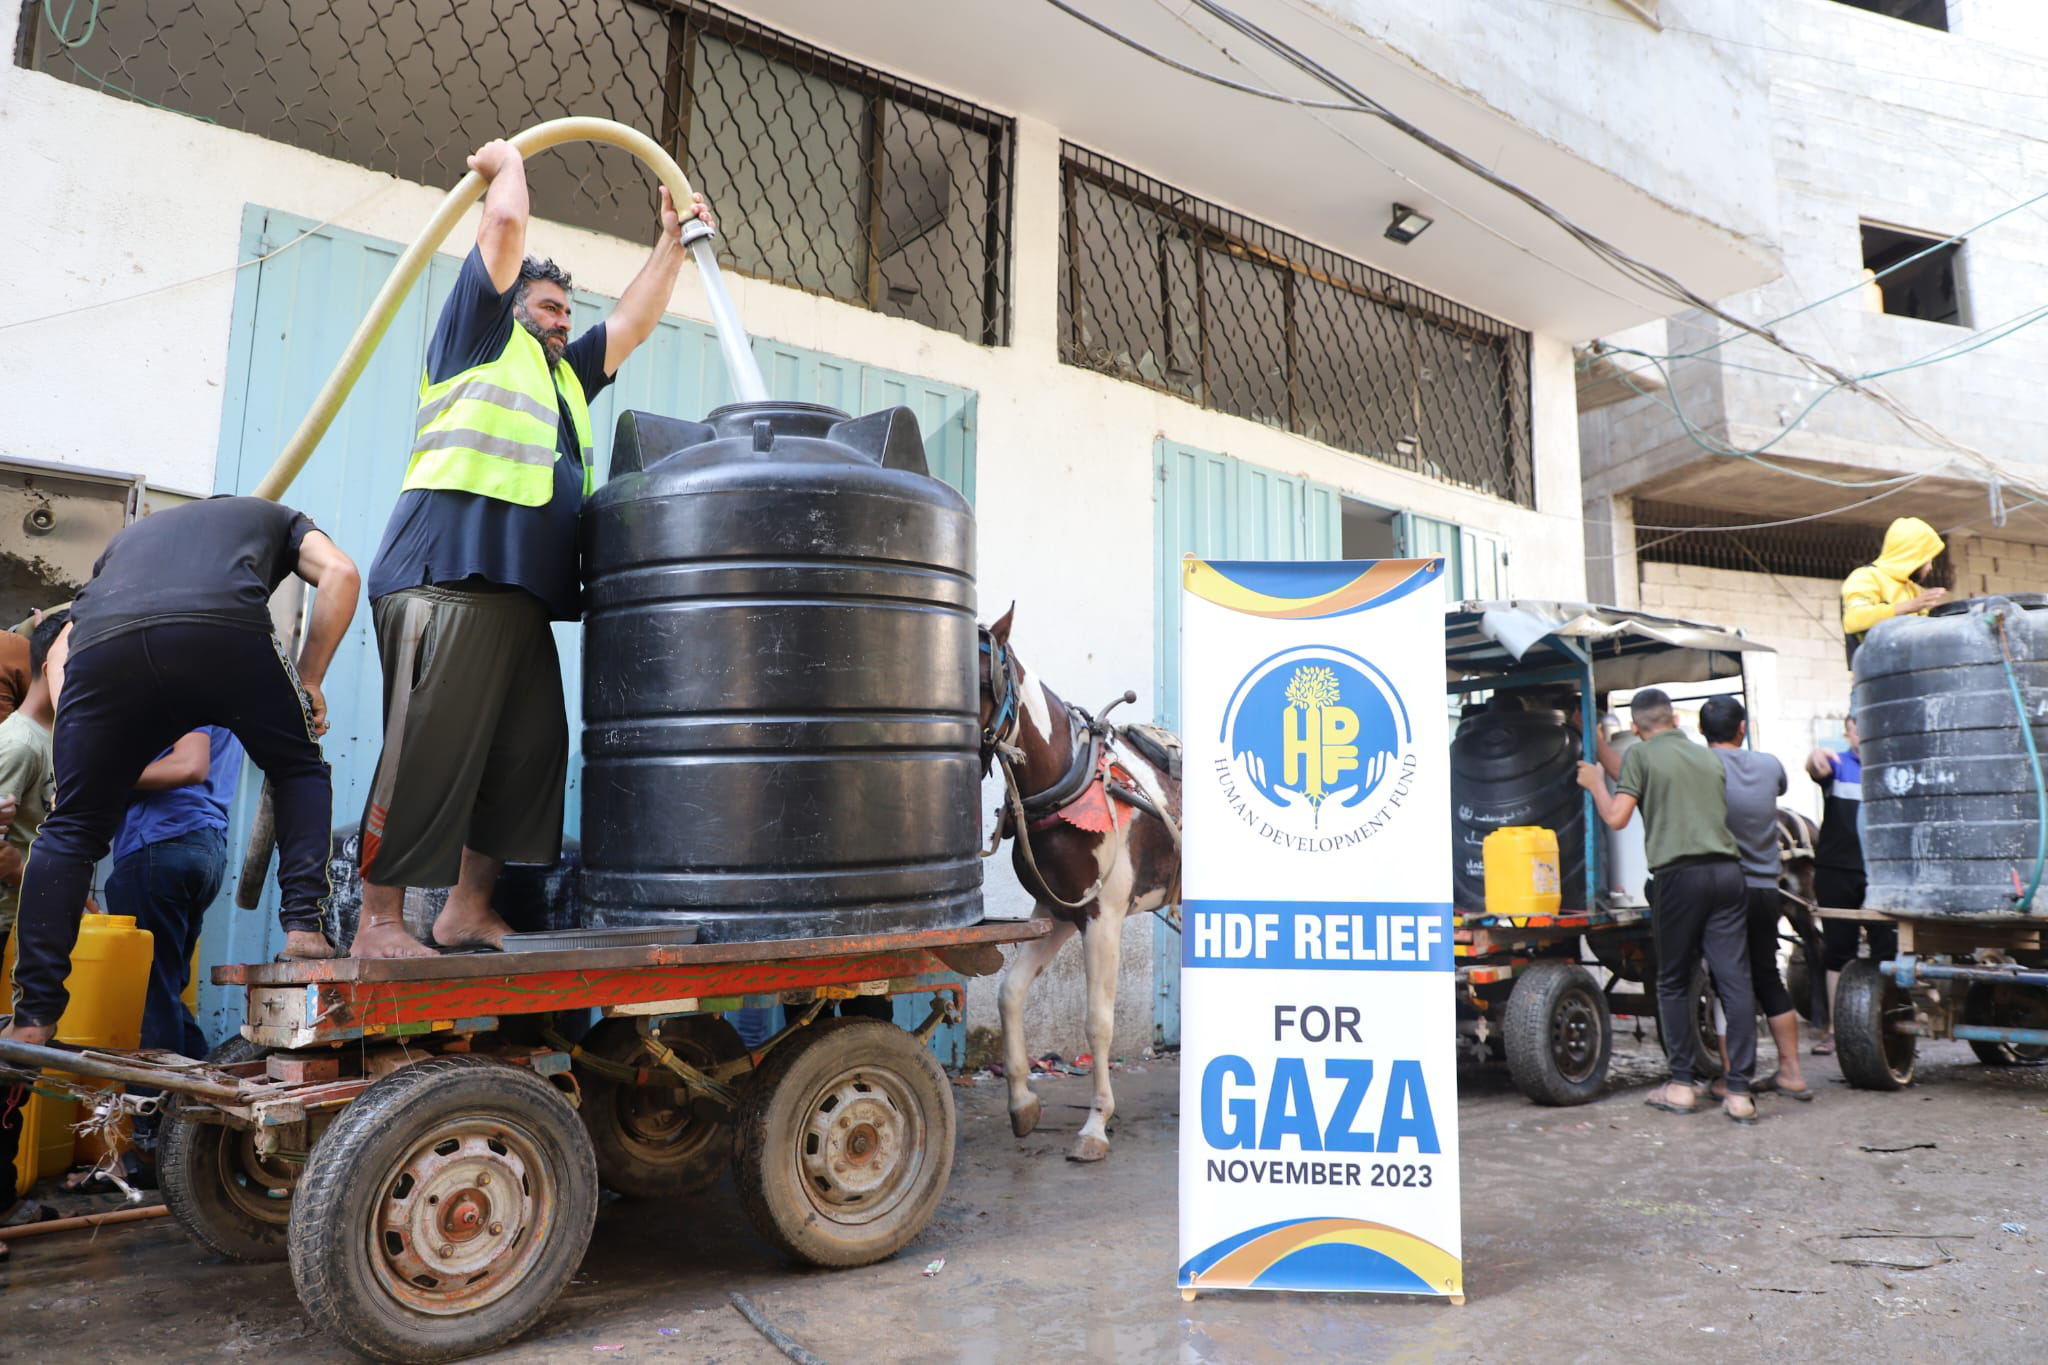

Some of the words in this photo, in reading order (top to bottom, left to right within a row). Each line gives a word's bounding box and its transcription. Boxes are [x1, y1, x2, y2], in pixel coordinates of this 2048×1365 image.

[1214, 756, 1260, 827] HUMAN
[1259, 807, 1393, 853] DEVELOPMENT
[1389, 753, 1418, 809] FUND
[1194, 913, 1279, 959] HDF
[1294, 915, 1442, 961] RELIEF
[1274, 1005, 1364, 1043] FOR
[1200, 1054, 1442, 1154] GAZA
[1206, 1159, 1362, 1186] NOVEMBER
[1370, 1163, 1433, 1188] 2023
